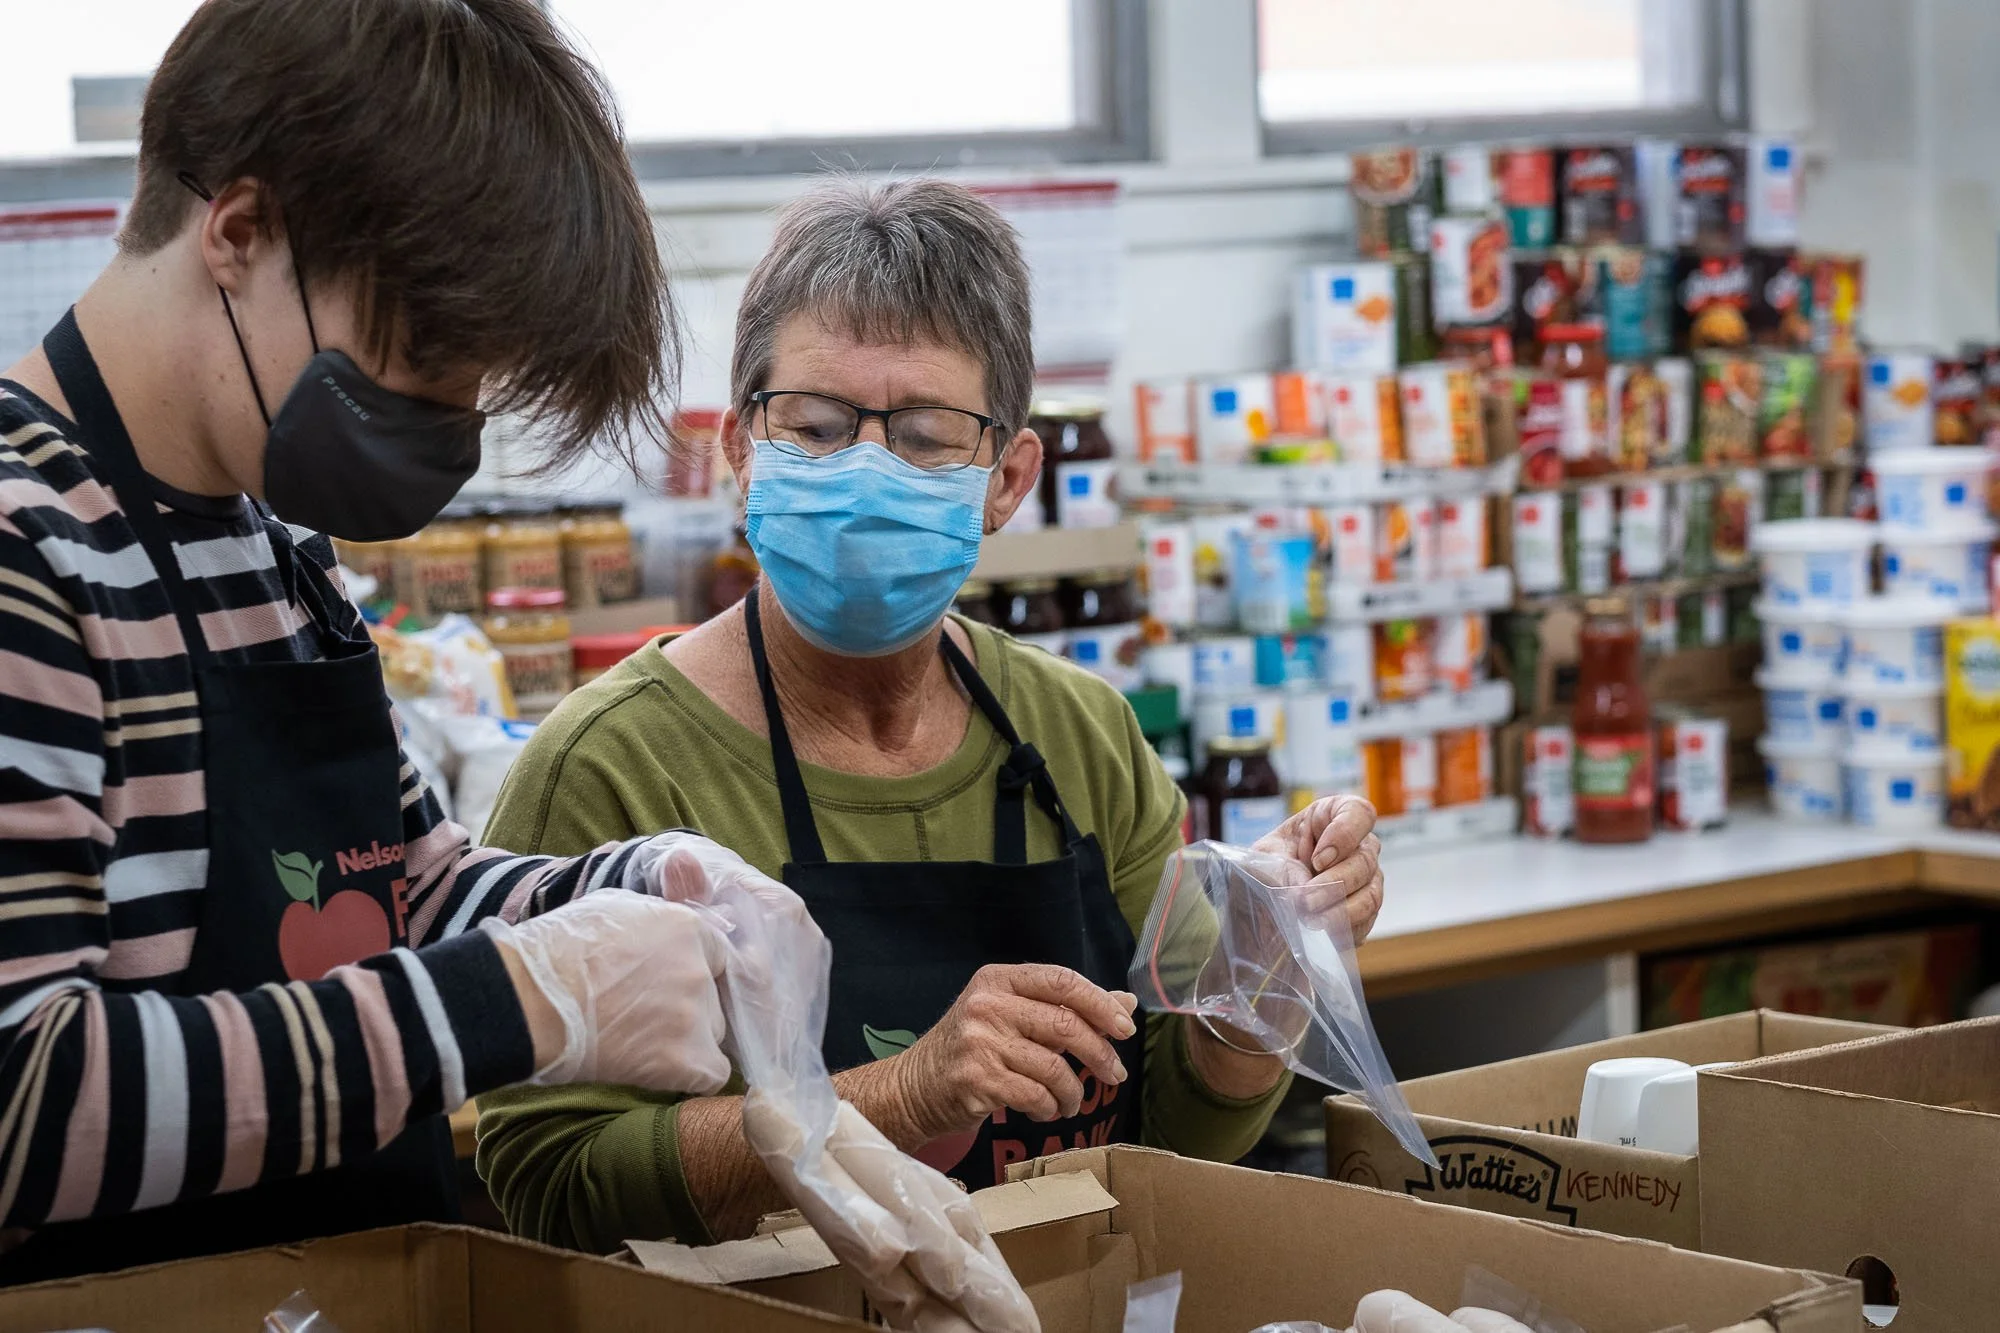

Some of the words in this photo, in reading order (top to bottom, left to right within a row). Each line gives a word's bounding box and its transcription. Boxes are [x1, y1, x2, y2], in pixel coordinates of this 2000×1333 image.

[322, 376, 370, 421] Precau
[336, 840, 405, 876] Nelso
[1438, 1152, 1541, 1204] Wattie's
[1566, 1167, 1682, 1213] KENNEDY
